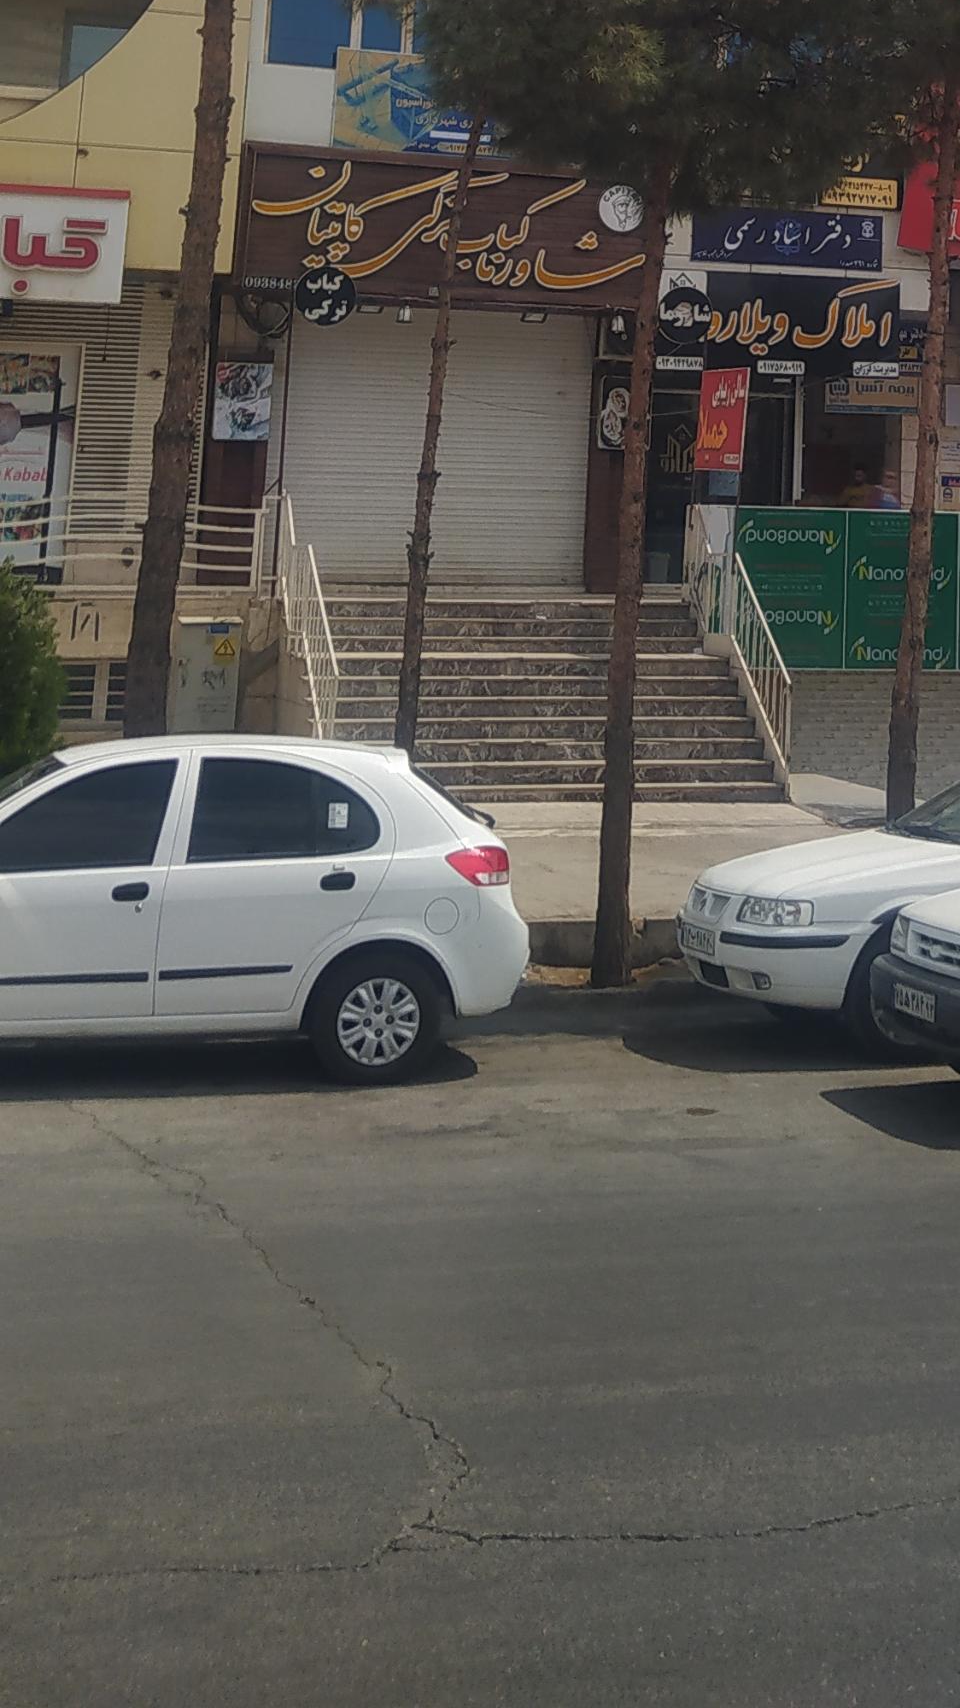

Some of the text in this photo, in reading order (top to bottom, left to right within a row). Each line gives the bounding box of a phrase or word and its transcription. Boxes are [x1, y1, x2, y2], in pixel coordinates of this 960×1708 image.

[724, 214, 851, 254] دفتر اسناد رسمی
[306, 273, 344, 294] کباب
[305, 299, 347, 322] ترکی
[659, 303, 711, 328] شاورما
[699, 278, 900, 356] املاک ویلارو
[745, 528, 834, 545] NanoBond
